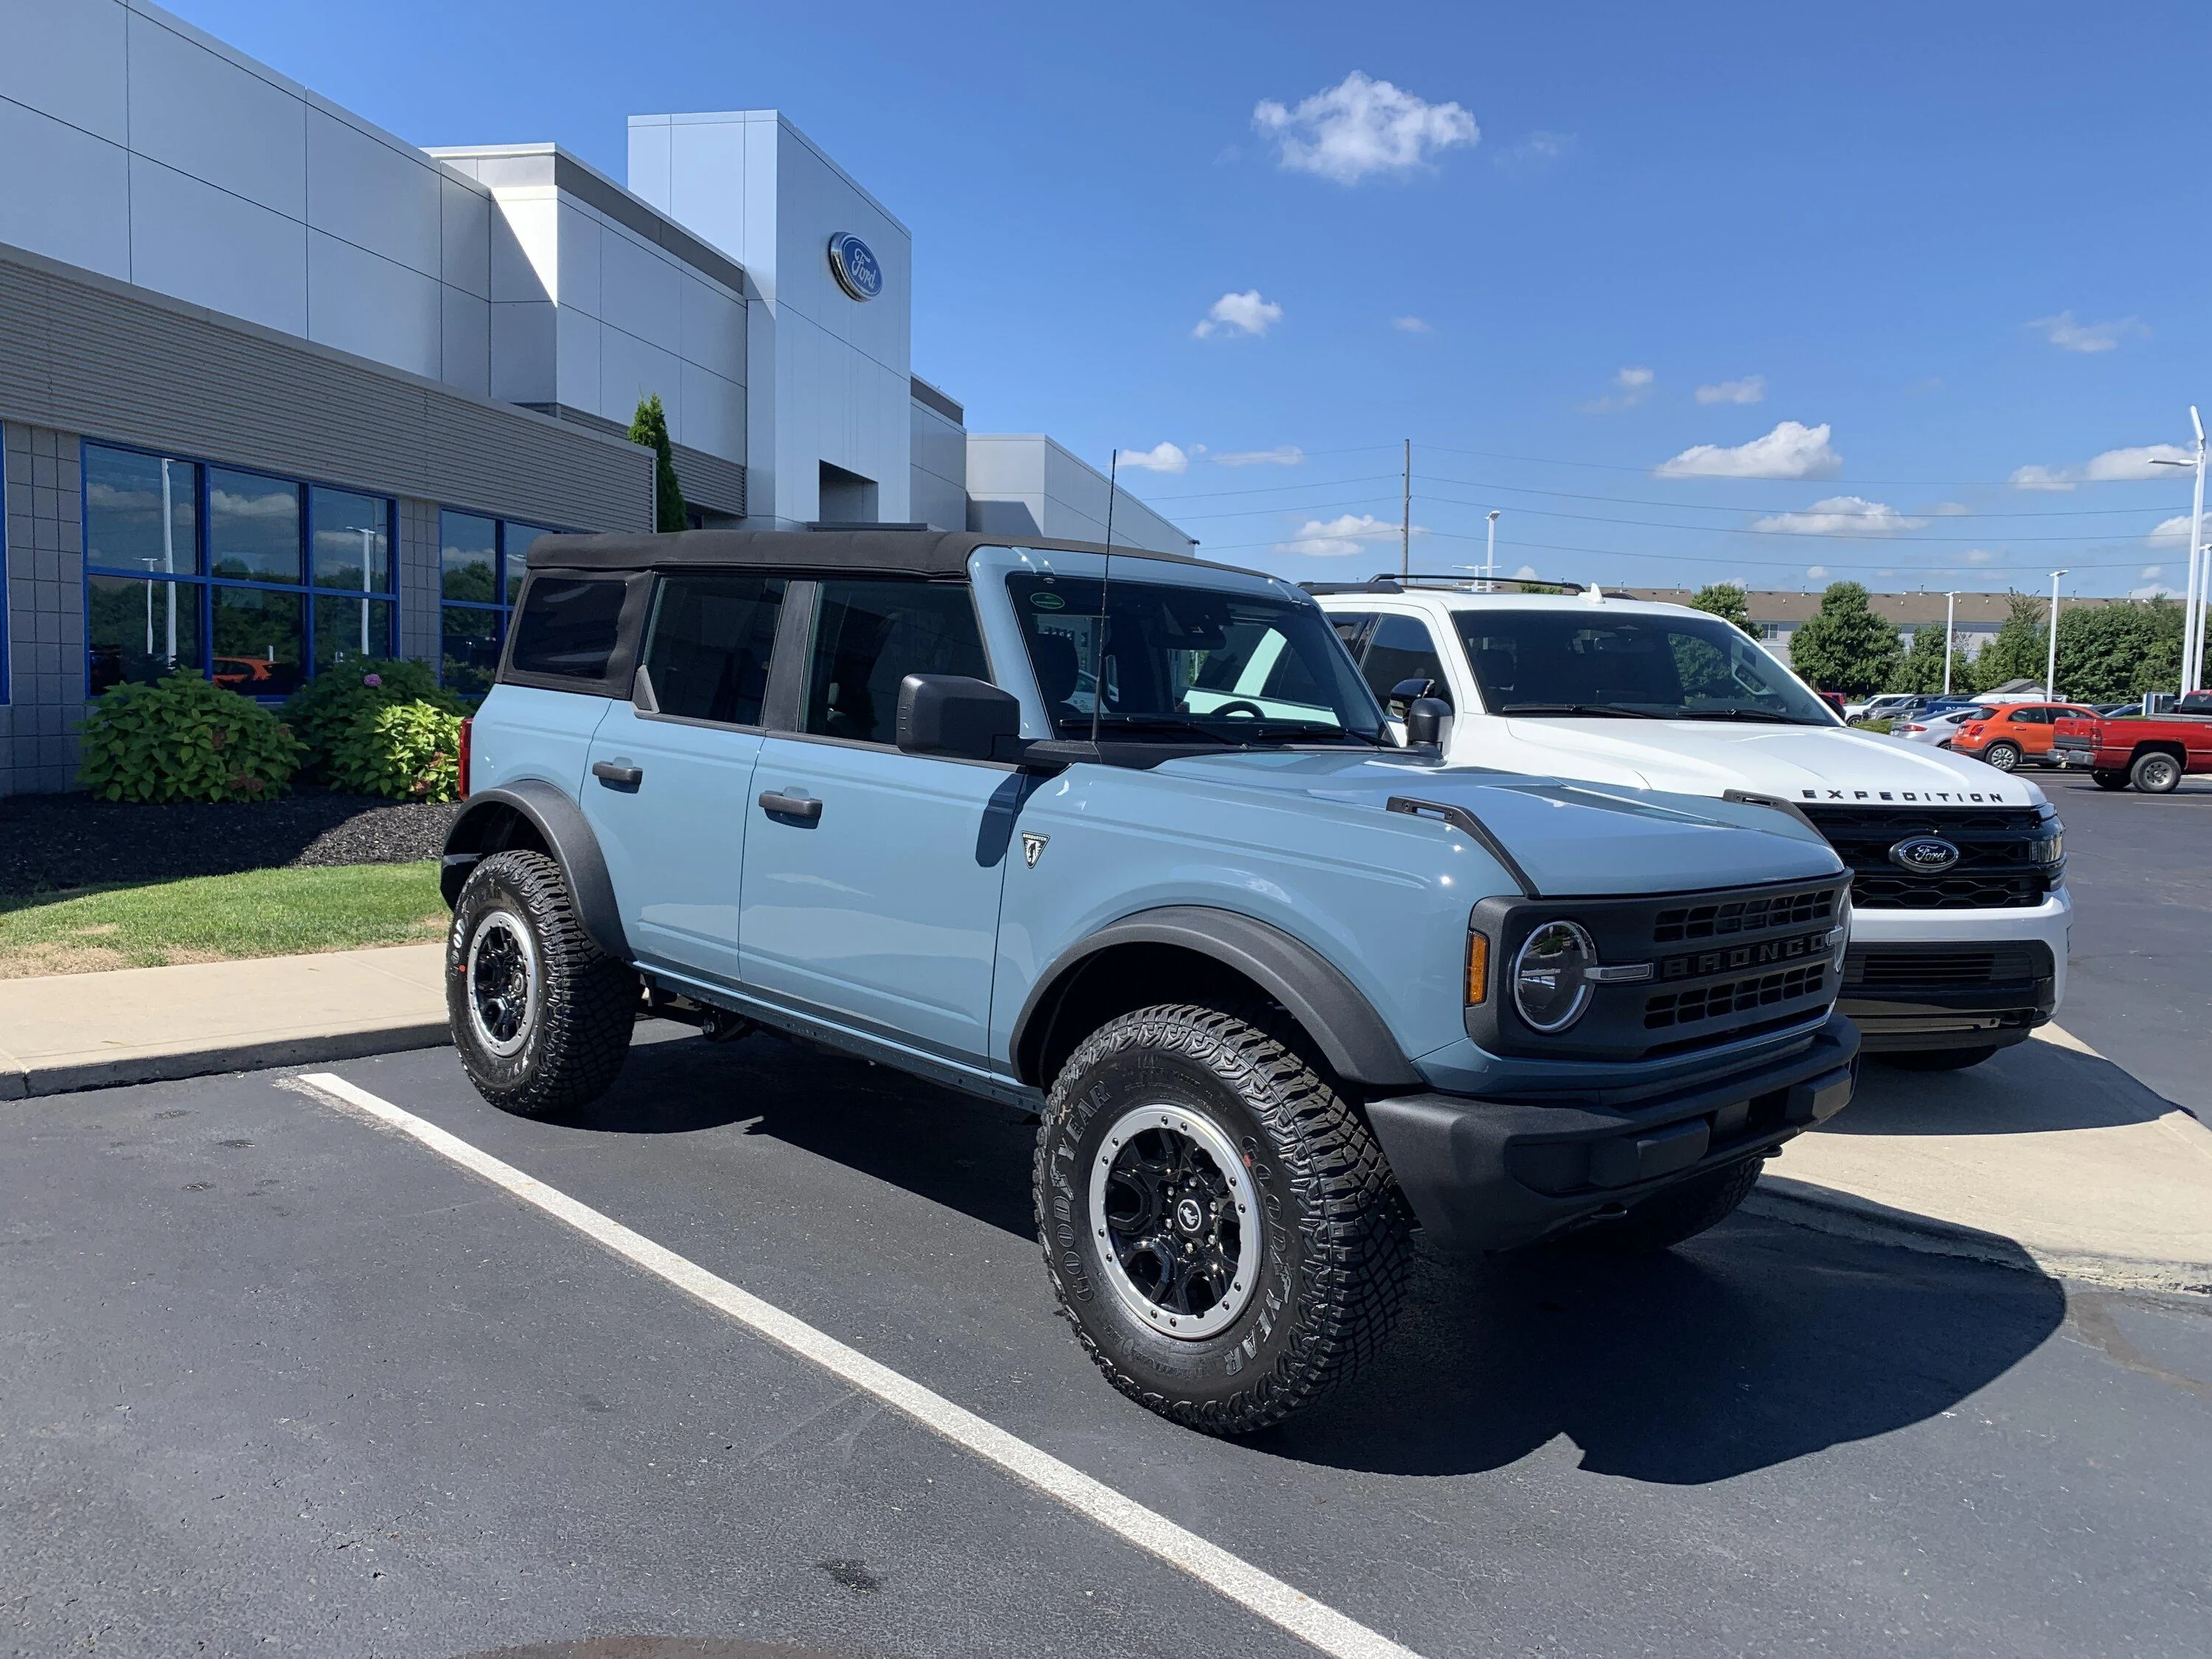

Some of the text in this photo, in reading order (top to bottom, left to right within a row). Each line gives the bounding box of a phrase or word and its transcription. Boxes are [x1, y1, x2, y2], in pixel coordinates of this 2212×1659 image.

[852, 248, 877, 289] Ford
[1801, 789, 2004, 804] EXPEDITION
[1914, 845, 1947, 862] Ford
[1663, 933, 1827, 978] BRONCO
[1054, 1080, 1112, 1302] GOODYEAR
